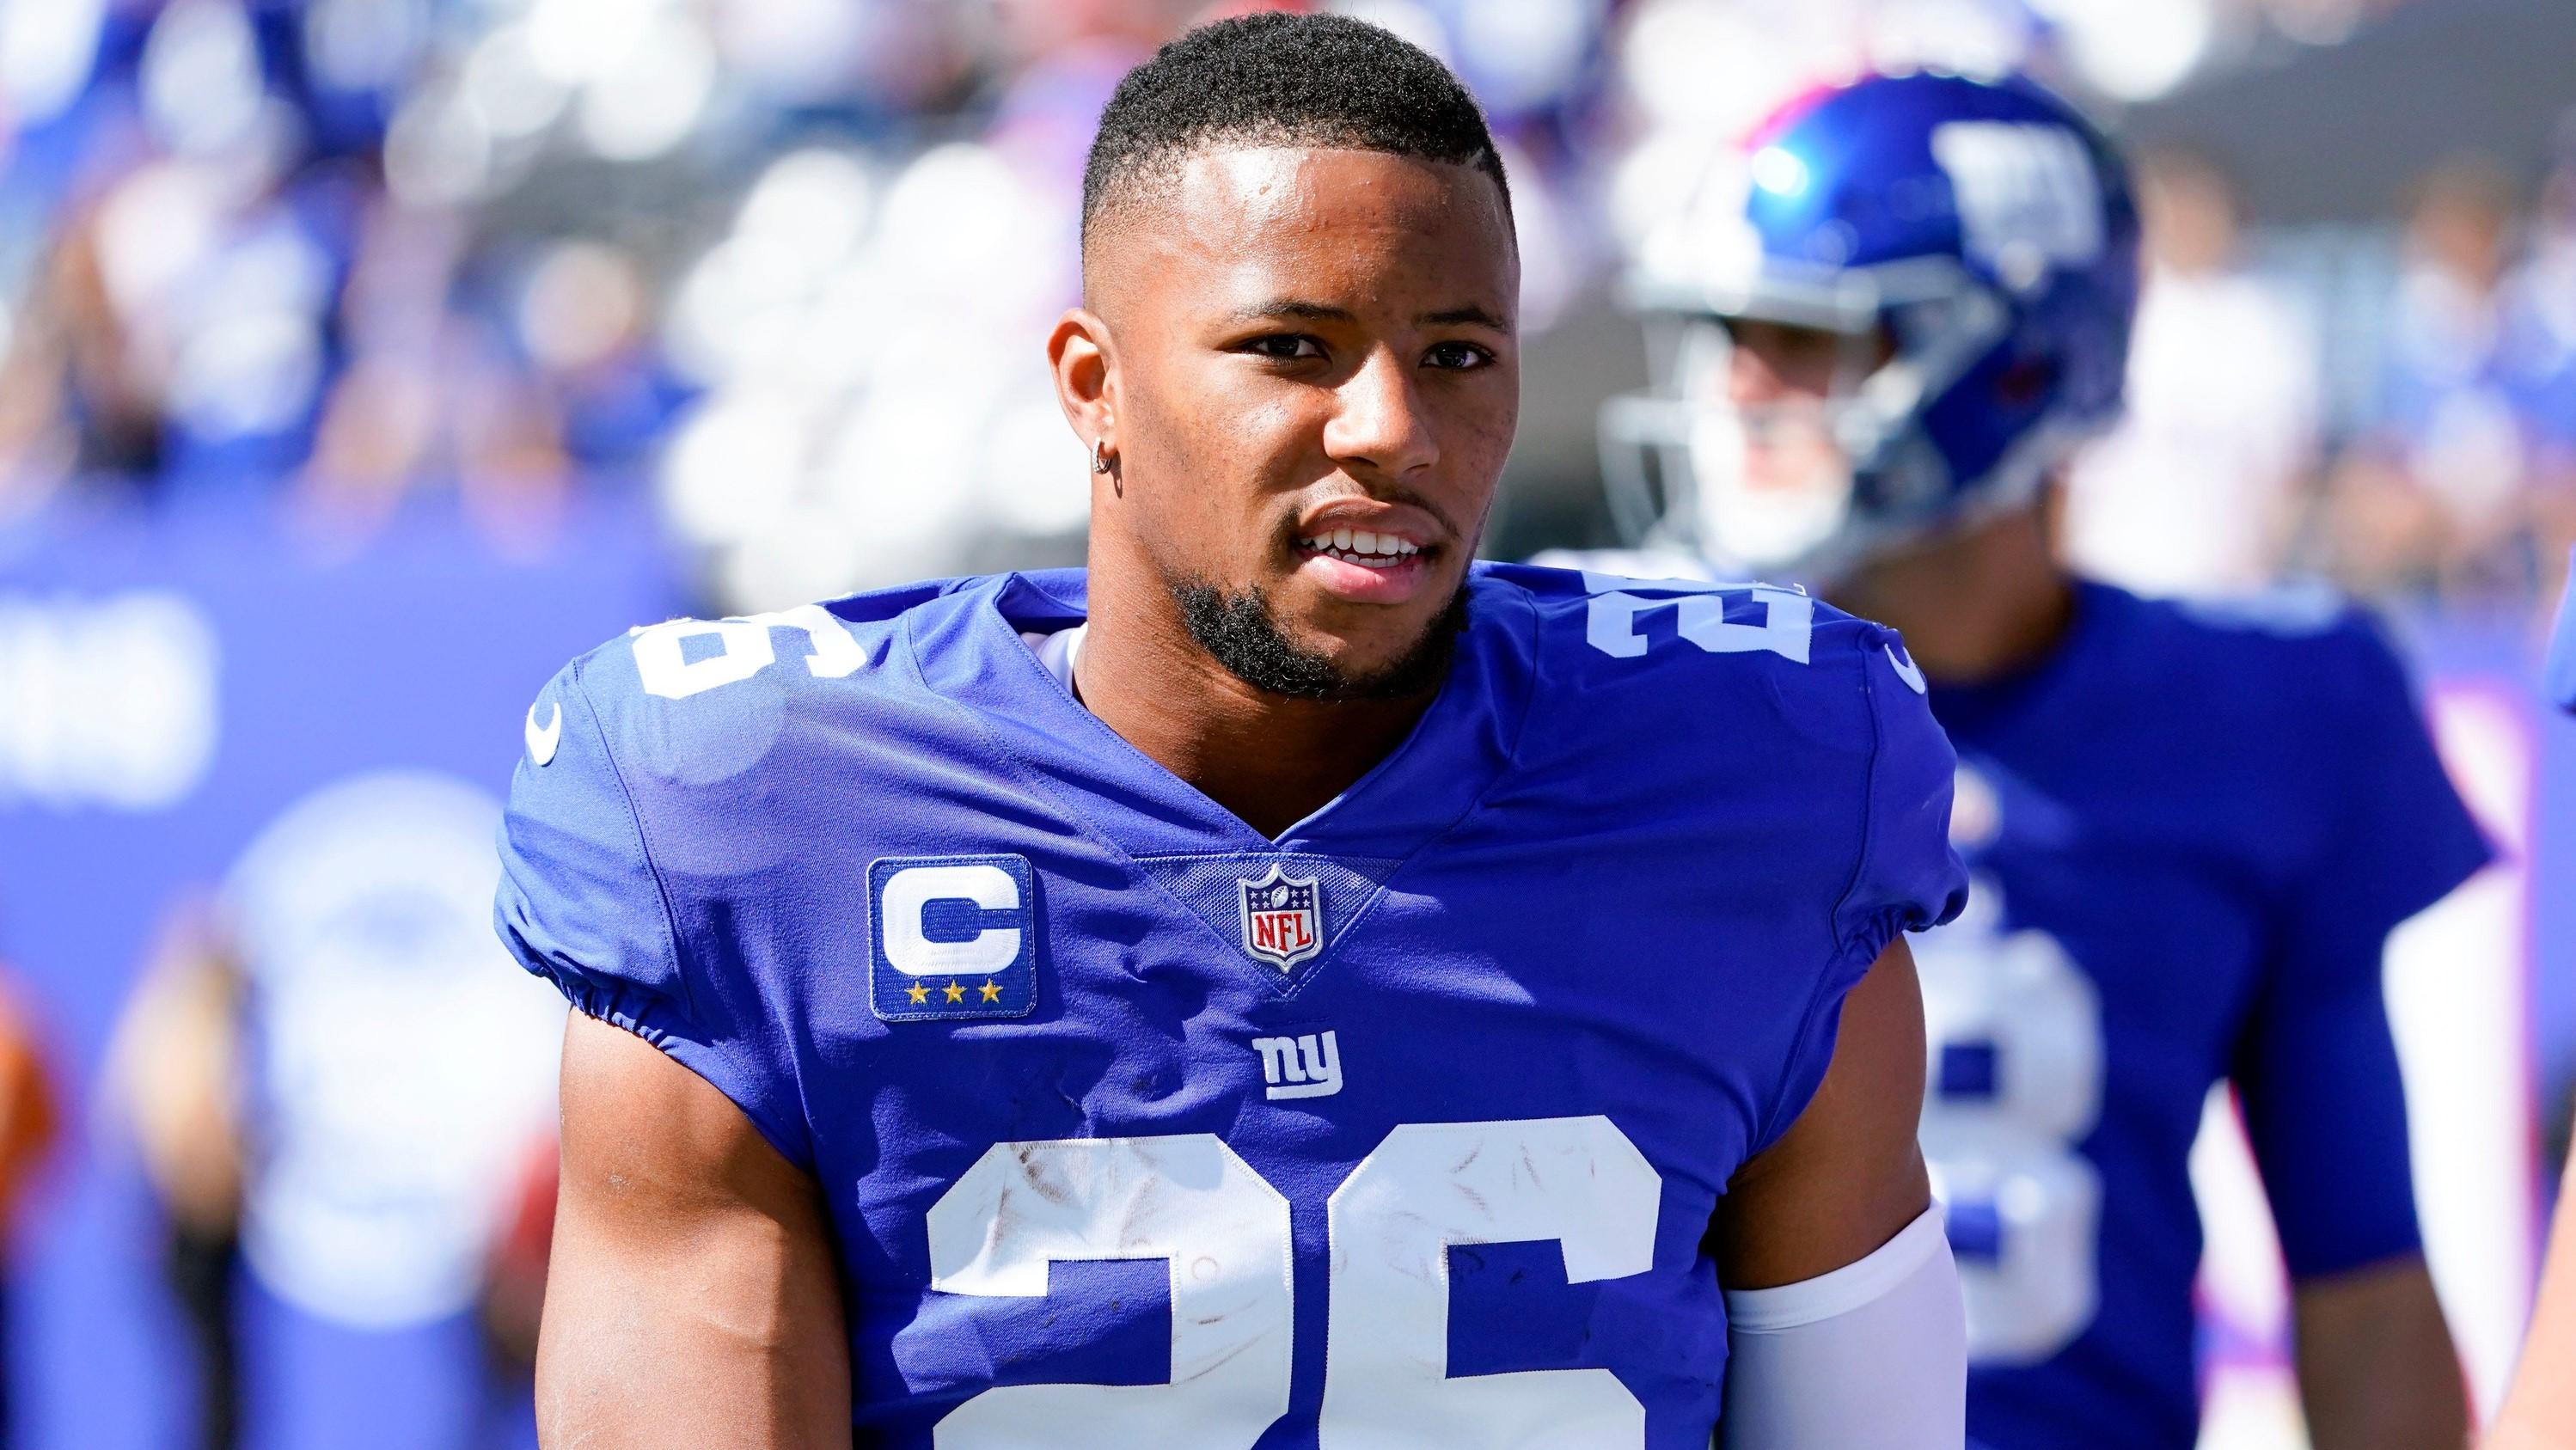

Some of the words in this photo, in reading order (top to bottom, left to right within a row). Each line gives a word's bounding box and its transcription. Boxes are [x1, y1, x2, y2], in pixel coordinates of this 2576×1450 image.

[882, 865, 1021, 976] C
[1254, 912, 1311, 952] NFL
[926, 1115, 1662, 1450] 26
